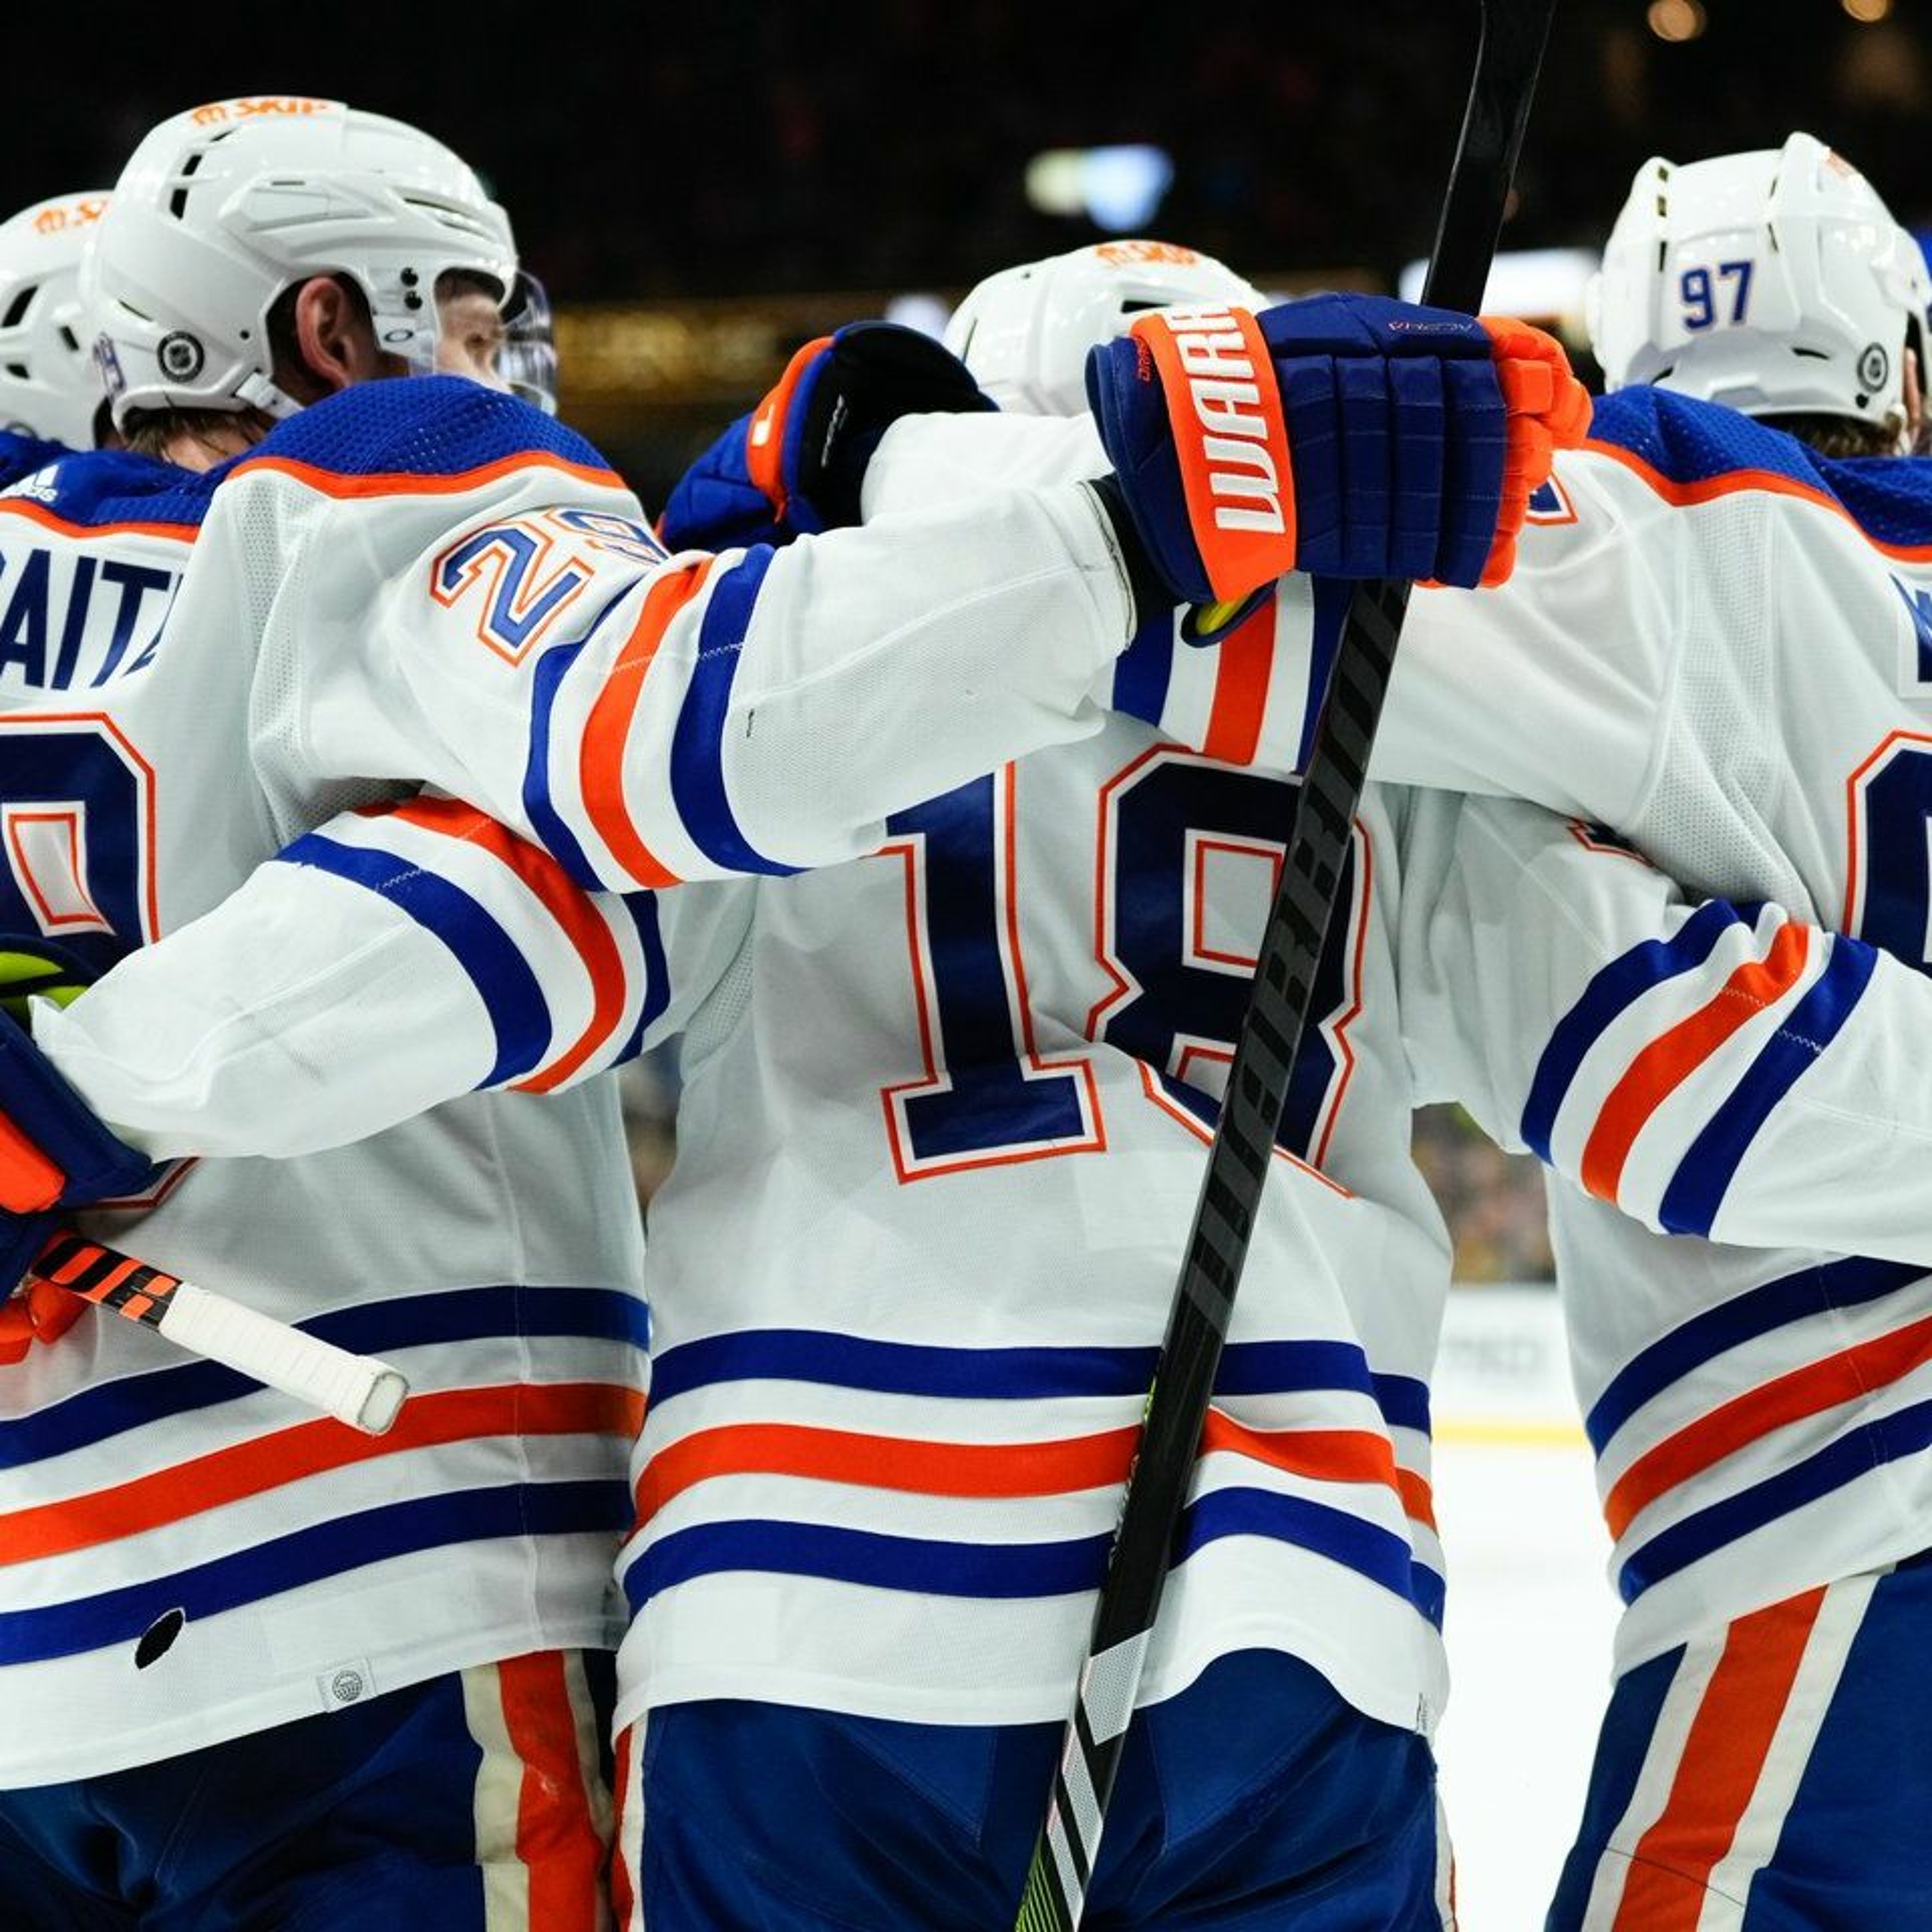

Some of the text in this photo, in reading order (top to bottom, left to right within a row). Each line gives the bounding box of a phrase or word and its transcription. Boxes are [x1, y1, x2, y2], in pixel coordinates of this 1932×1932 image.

[1680, 260, 1753, 330] 97
[0, 547, 183, 691] AIT
[860, 742, 1373, 1199] 18
